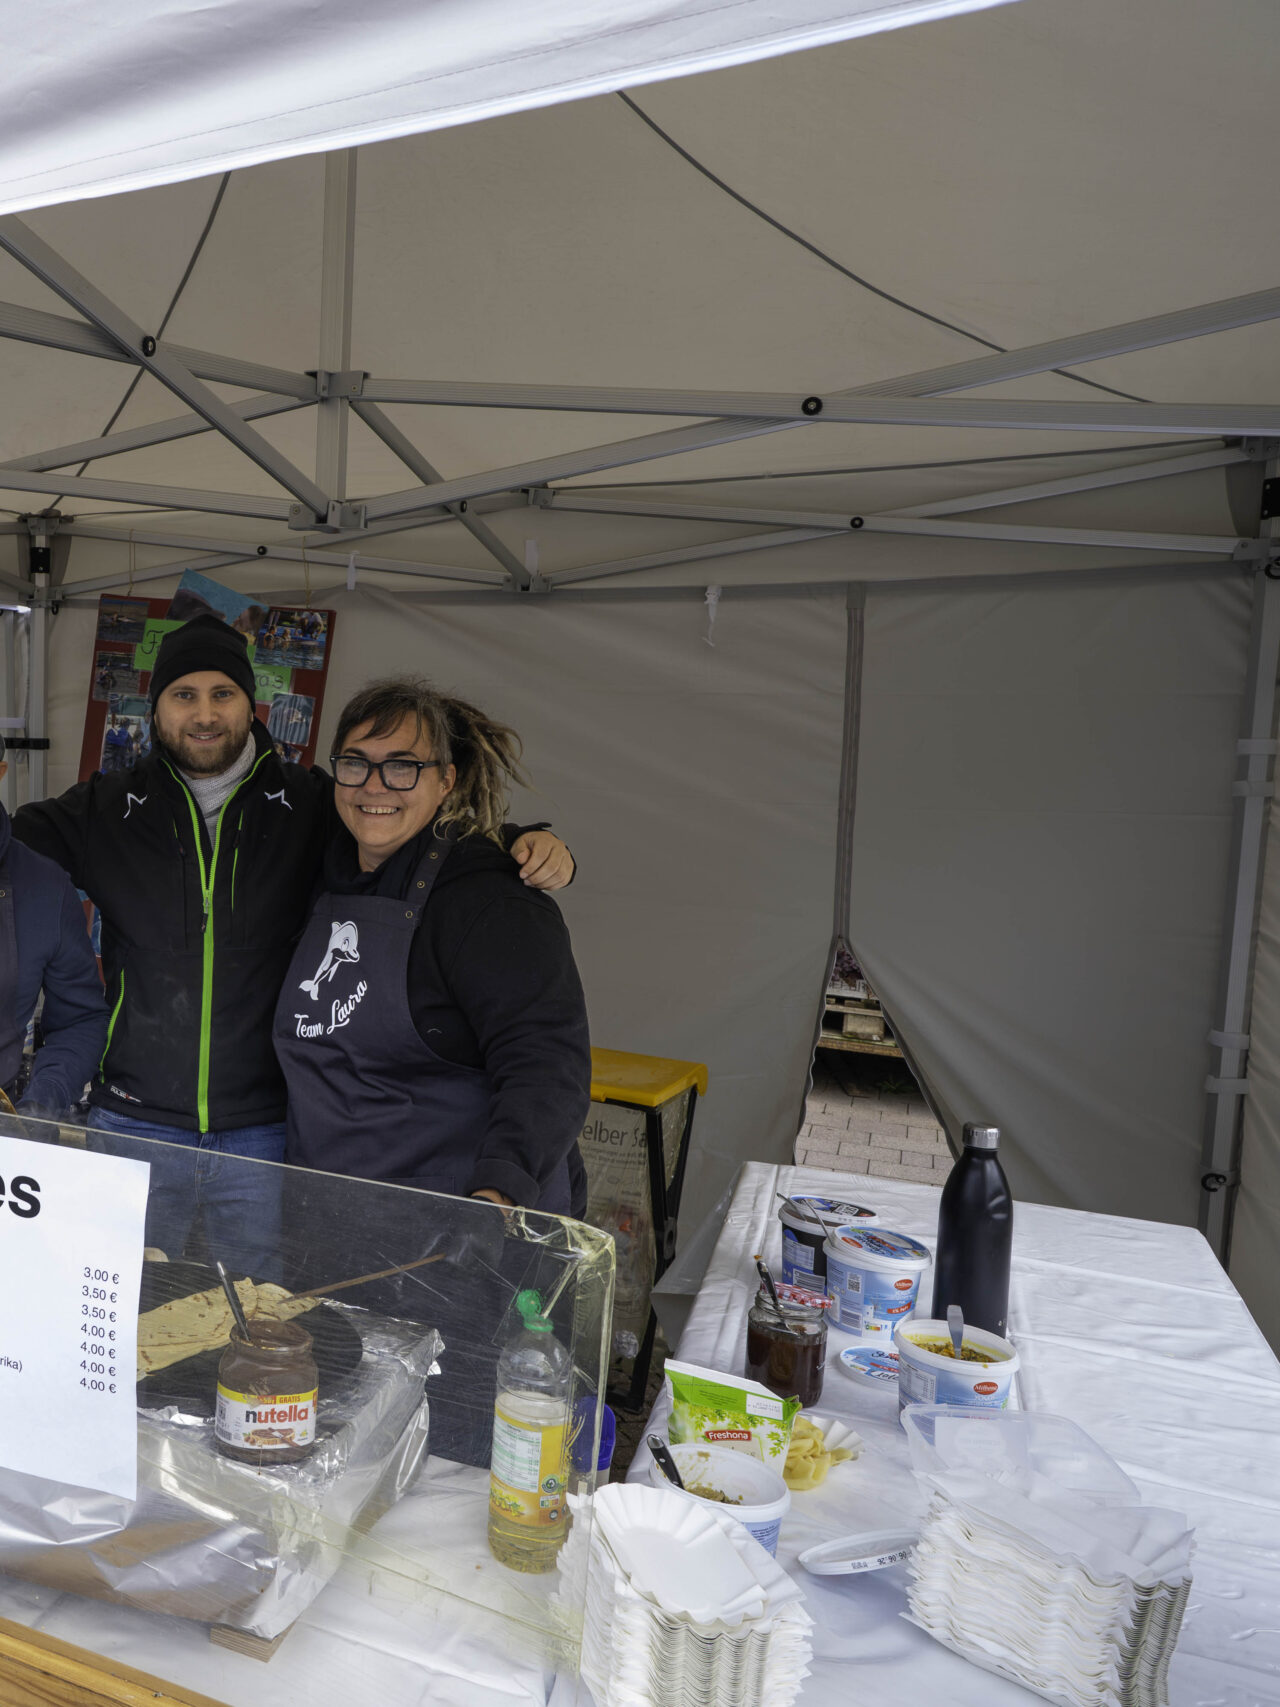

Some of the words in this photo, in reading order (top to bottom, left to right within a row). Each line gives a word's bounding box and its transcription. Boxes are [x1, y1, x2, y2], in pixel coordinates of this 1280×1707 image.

[294, 1013, 324, 1038] Team
[326, 980, 368, 1035] Laura
[582, 1120, 628, 1147] elber
[83, 1267, 108, 1282] 3,00
[112, 1273, 119, 1284] €
[82, 1285, 106, 1300] 3,50
[110, 1292, 117, 1303] €
[81, 1304, 106, 1320] 3,50
[109, 1312, 117, 1322] €
[80, 1323, 105, 1338] 4,00
[108, 1330, 116, 1341] €
[80, 1342, 105, 1356] 4,00
[108, 1349, 116, 1359] €
[80, 1360, 105, 1374] 4,00
[108, 1366, 116, 1377] €
[80, 1378, 105, 1392] 4,00
[109, 1383, 117, 1394] €
[245, 1405, 309, 1424] nutella
[708, 1431, 749, 1440] Freshona
